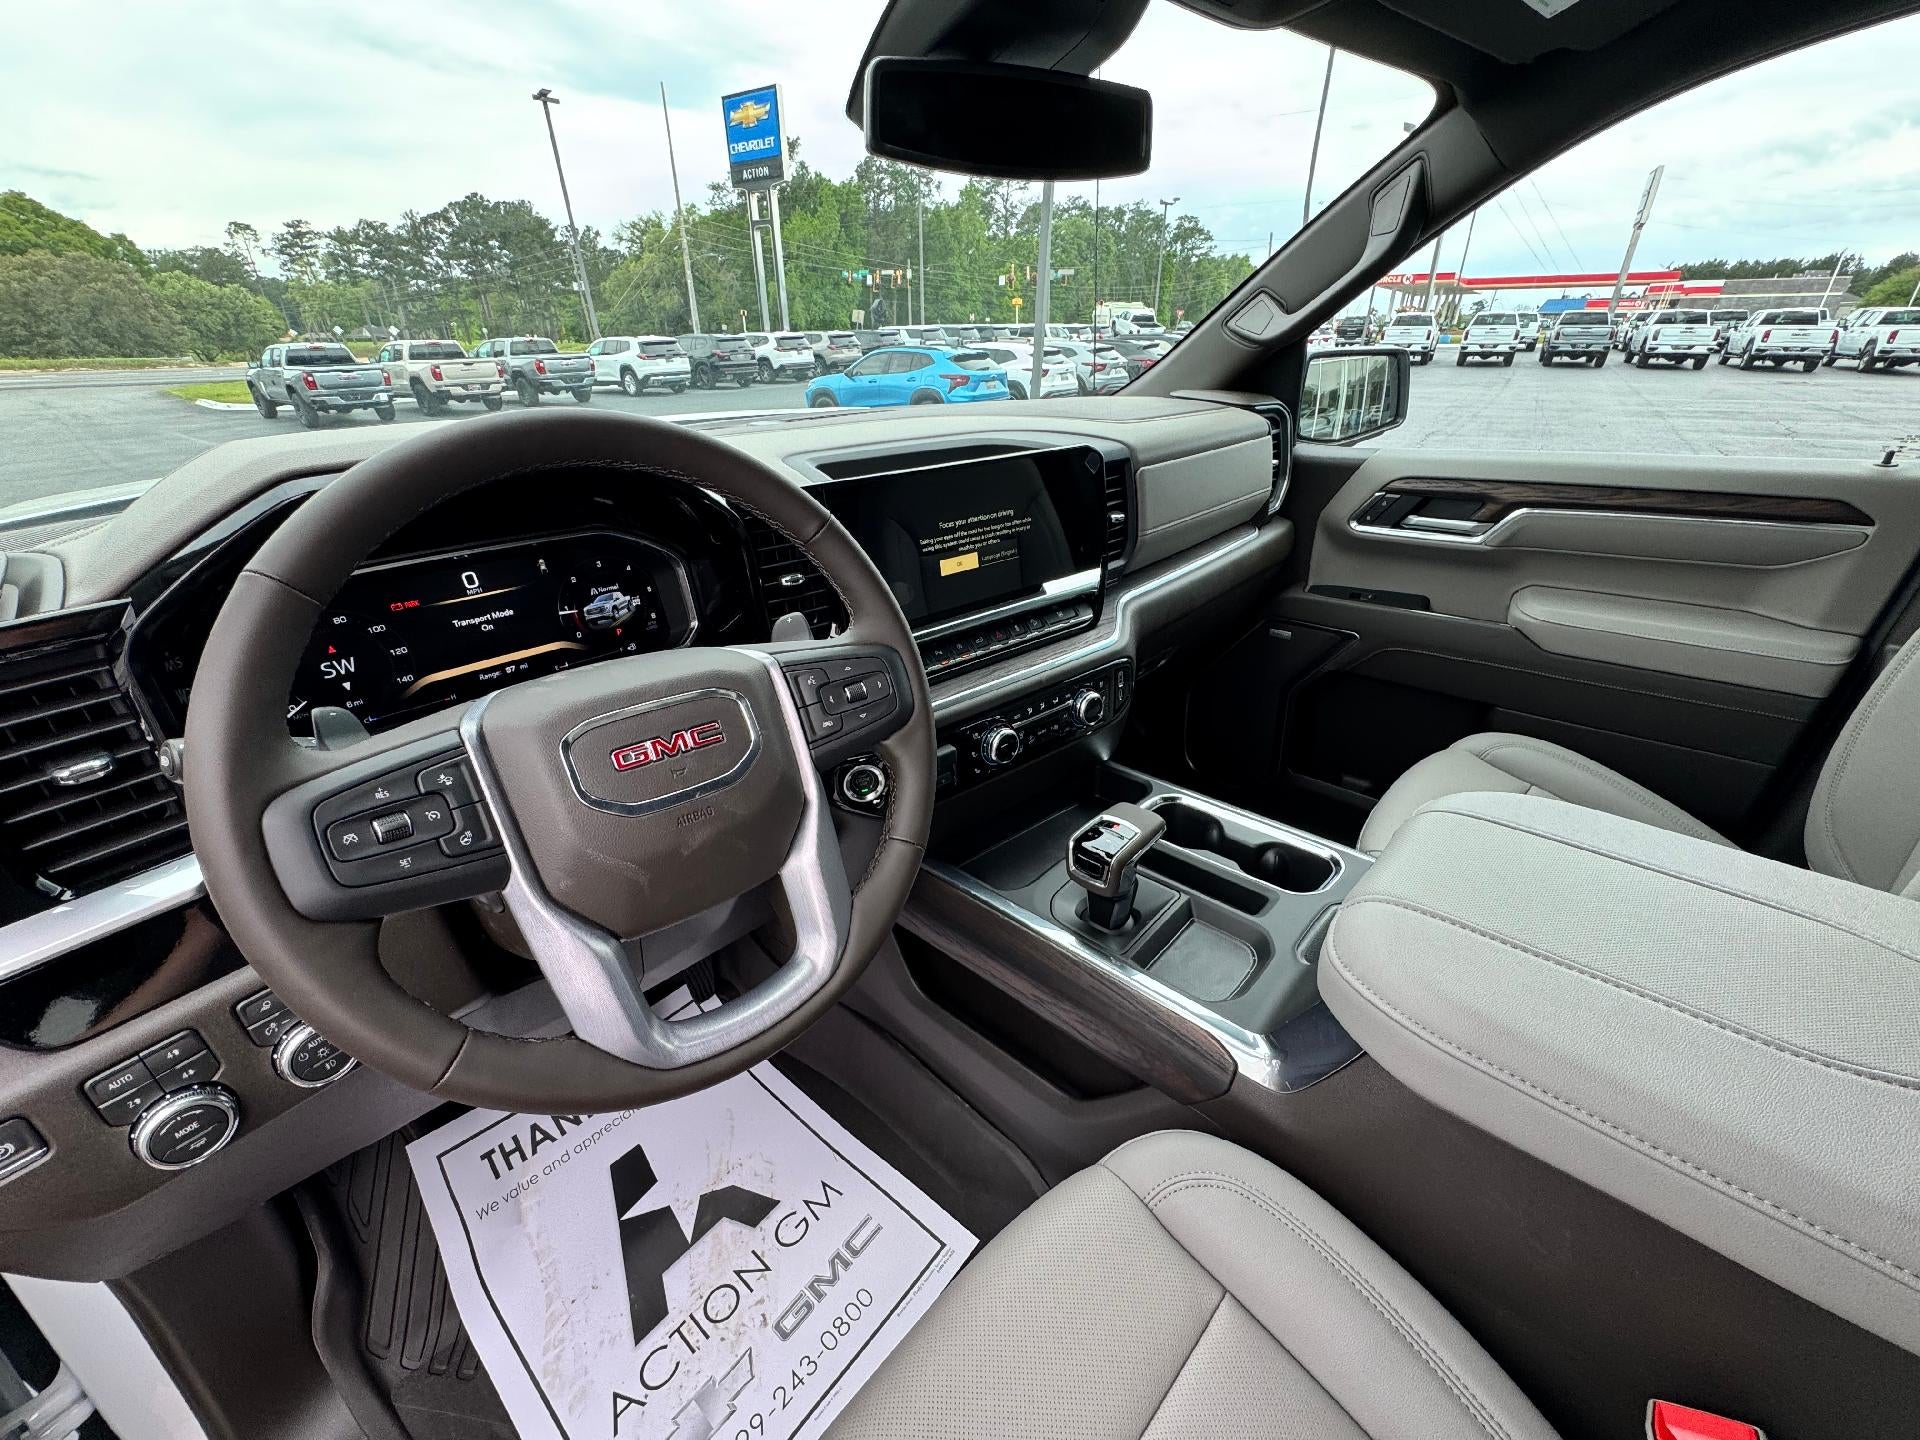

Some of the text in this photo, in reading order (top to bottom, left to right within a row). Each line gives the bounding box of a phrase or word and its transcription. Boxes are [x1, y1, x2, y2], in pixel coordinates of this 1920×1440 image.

[729, 136, 775, 155] CHEVROLET
[742, 166, 769, 180] ACTION
[461, 571, 480, 589] 0
[597, 583, 619, 593] Normal
[466, 587, 483, 596] MPH
[332, 615, 348, 625] 80
[452, 607, 514, 628] Transport Mode
[367, 624, 386, 635] 100
[481, 623, 494, 632] On
[389, 646, 408, 656] 120
[319, 656, 356, 680] SW
[396, 673, 415, 685] 140
[611, 720, 727, 772] GMC
[374, 789, 390, 800] RES
[677, 805, 715, 828] AIRBAG
[399, 857, 413, 867] SET
[108, 1073, 134, 1091] AUTO
[174, 1120, 201, 1139] MODE
[480, 1113, 594, 1180] THAN
[475, 1199, 500, 1221] We
[502, 1173, 539, 1204] value
[542, 1149, 571, 1177] and
[771, 1213, 884, 1342] GMC
[612, 1180, 843, 1438] ACTION GM
